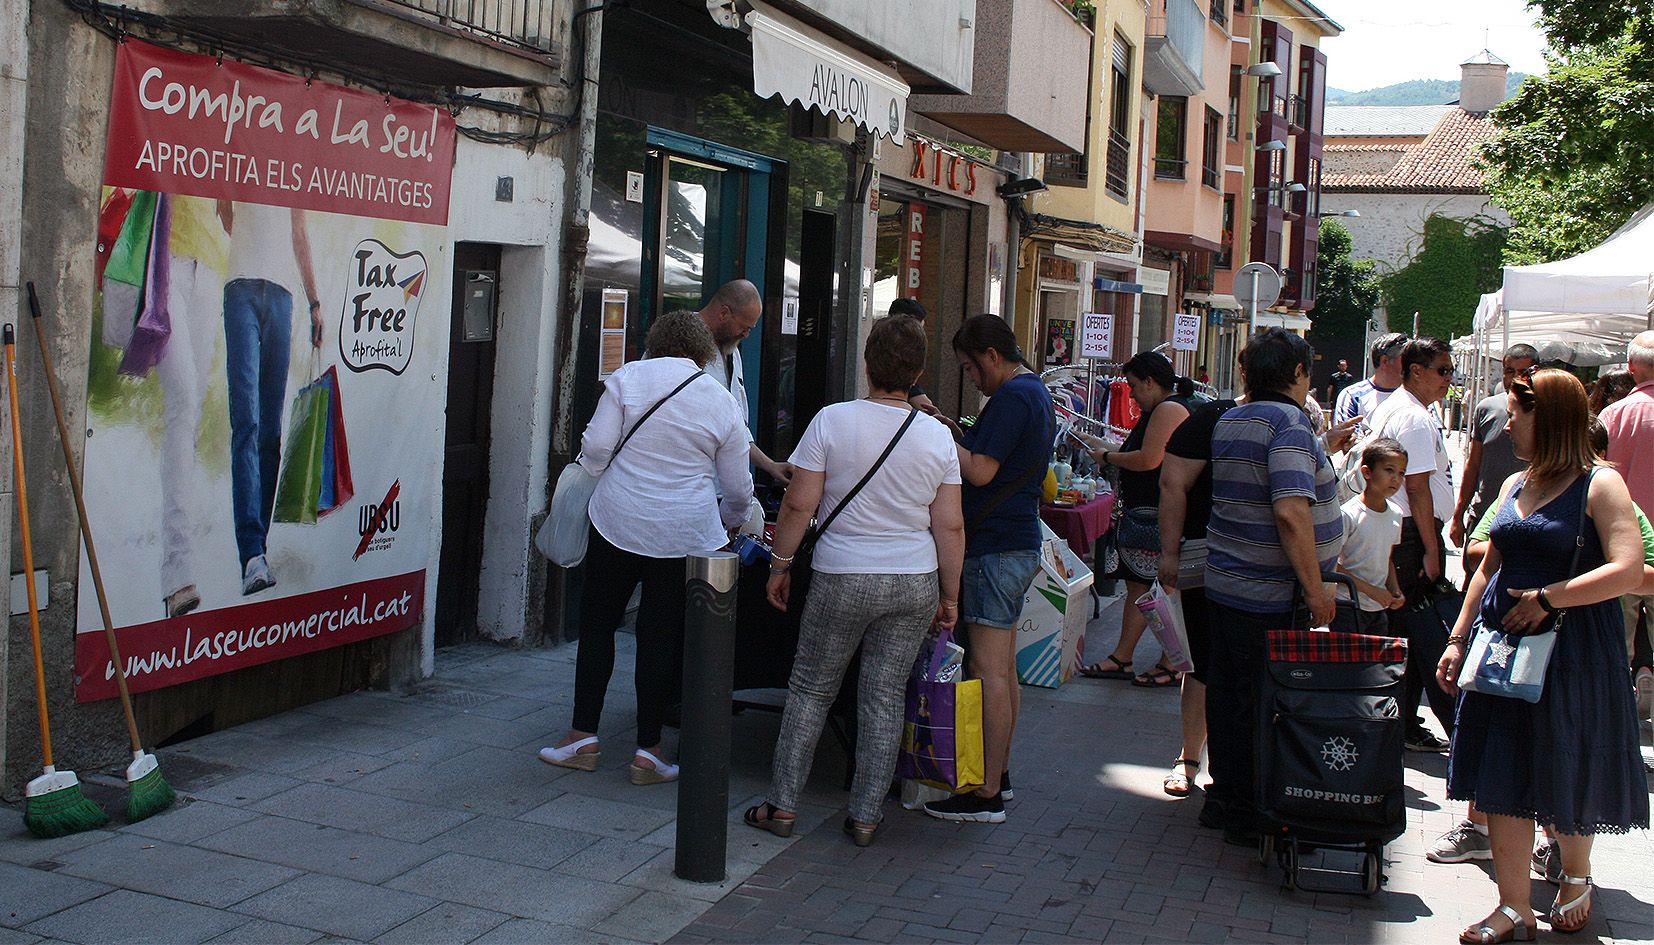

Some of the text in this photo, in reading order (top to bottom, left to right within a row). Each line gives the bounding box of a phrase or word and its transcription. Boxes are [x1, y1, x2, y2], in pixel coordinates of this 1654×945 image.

[139, 66, 438, 162] Compra a La Seu!
[809, 63, 868, 121] AVALON
[135, 139, 433, 209] APROFITA ELS AVANTATGES
[910, 141, 977, 196] XICS
[355, 249, 398, 289] Tax
[908, 211, 923, 300] REB
[352, 292, 406, 334] Free
[1086, 315, 1110, 330] OFERTES
[105, 590, 412, 681] www.laseucomercial.cat
[1285, 786, 1361, 804] SHOPPING
